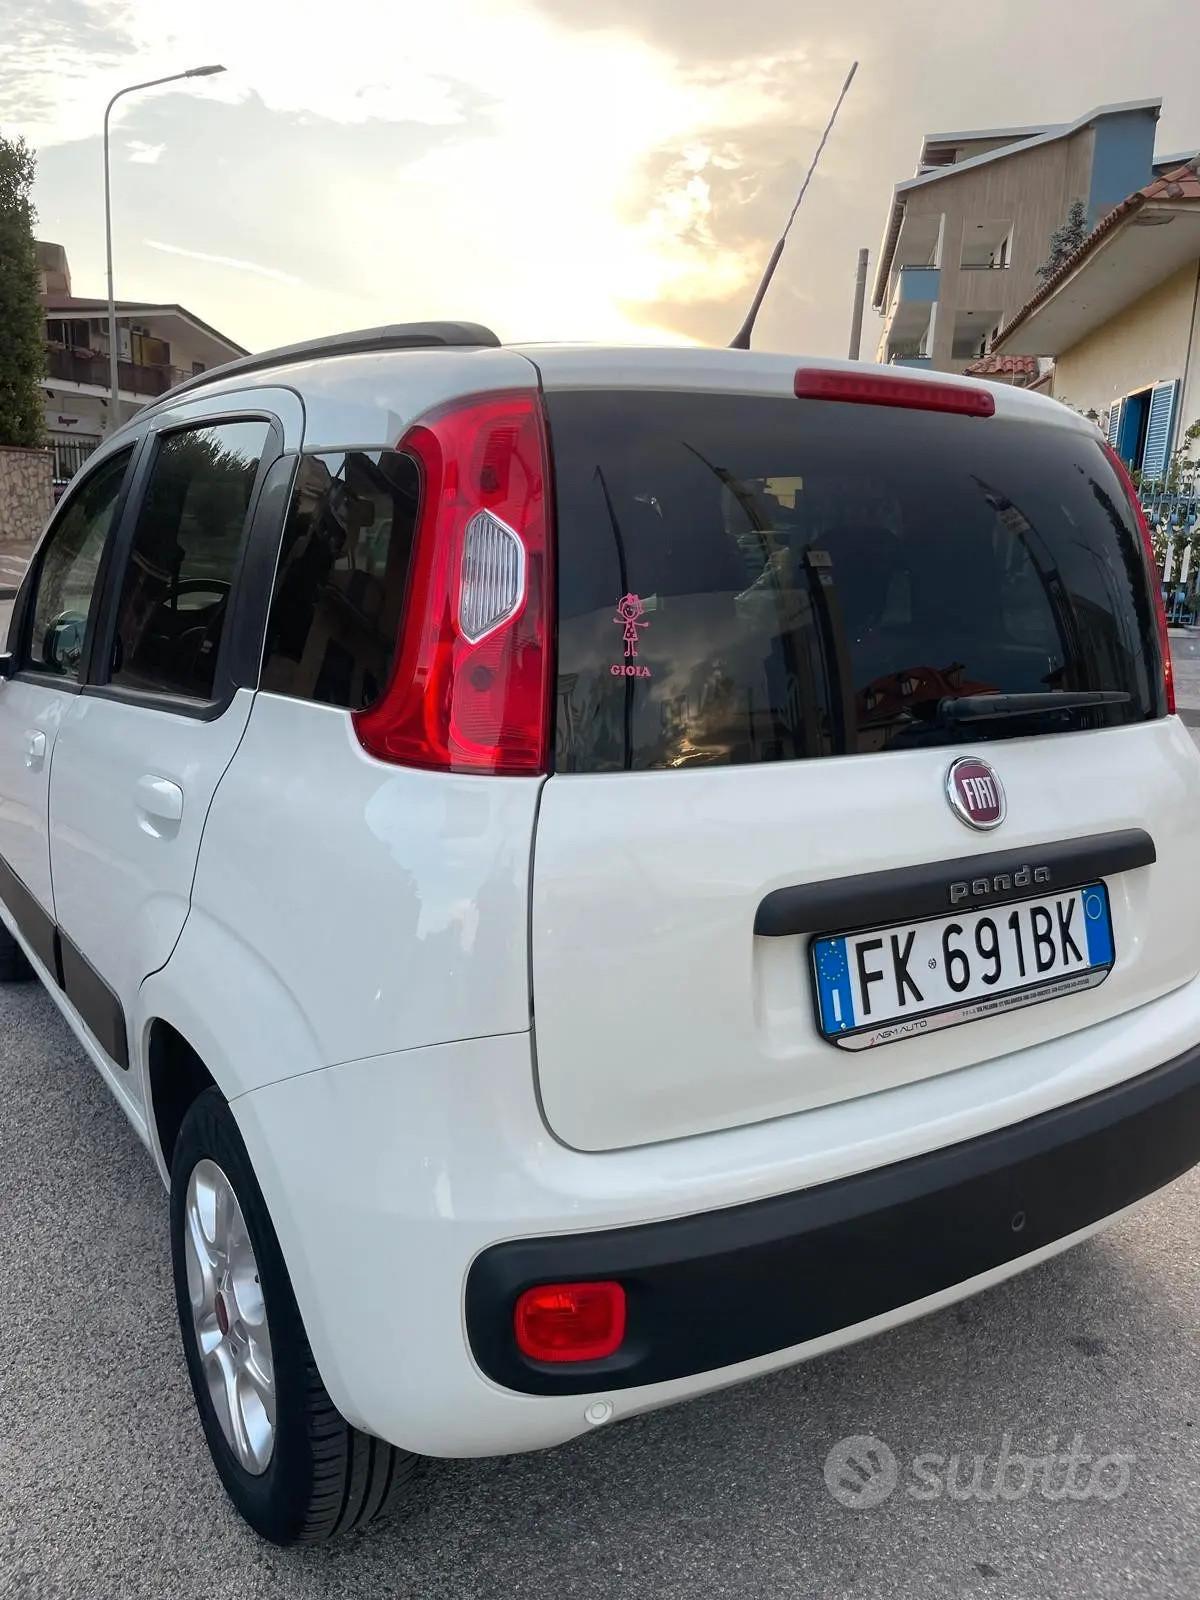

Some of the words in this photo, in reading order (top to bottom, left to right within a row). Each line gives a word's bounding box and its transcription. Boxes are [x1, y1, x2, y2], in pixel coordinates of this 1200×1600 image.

[610, 664, 652, 677] GIOIA
[961, 776, 997, 810] FIAT
[950, 864, 1050, 904] panda
[855, 930, 925, 1016] FK
[941, 897, 1084, 993] 691BK
[900, 1020, 928, 1033] AUTO
